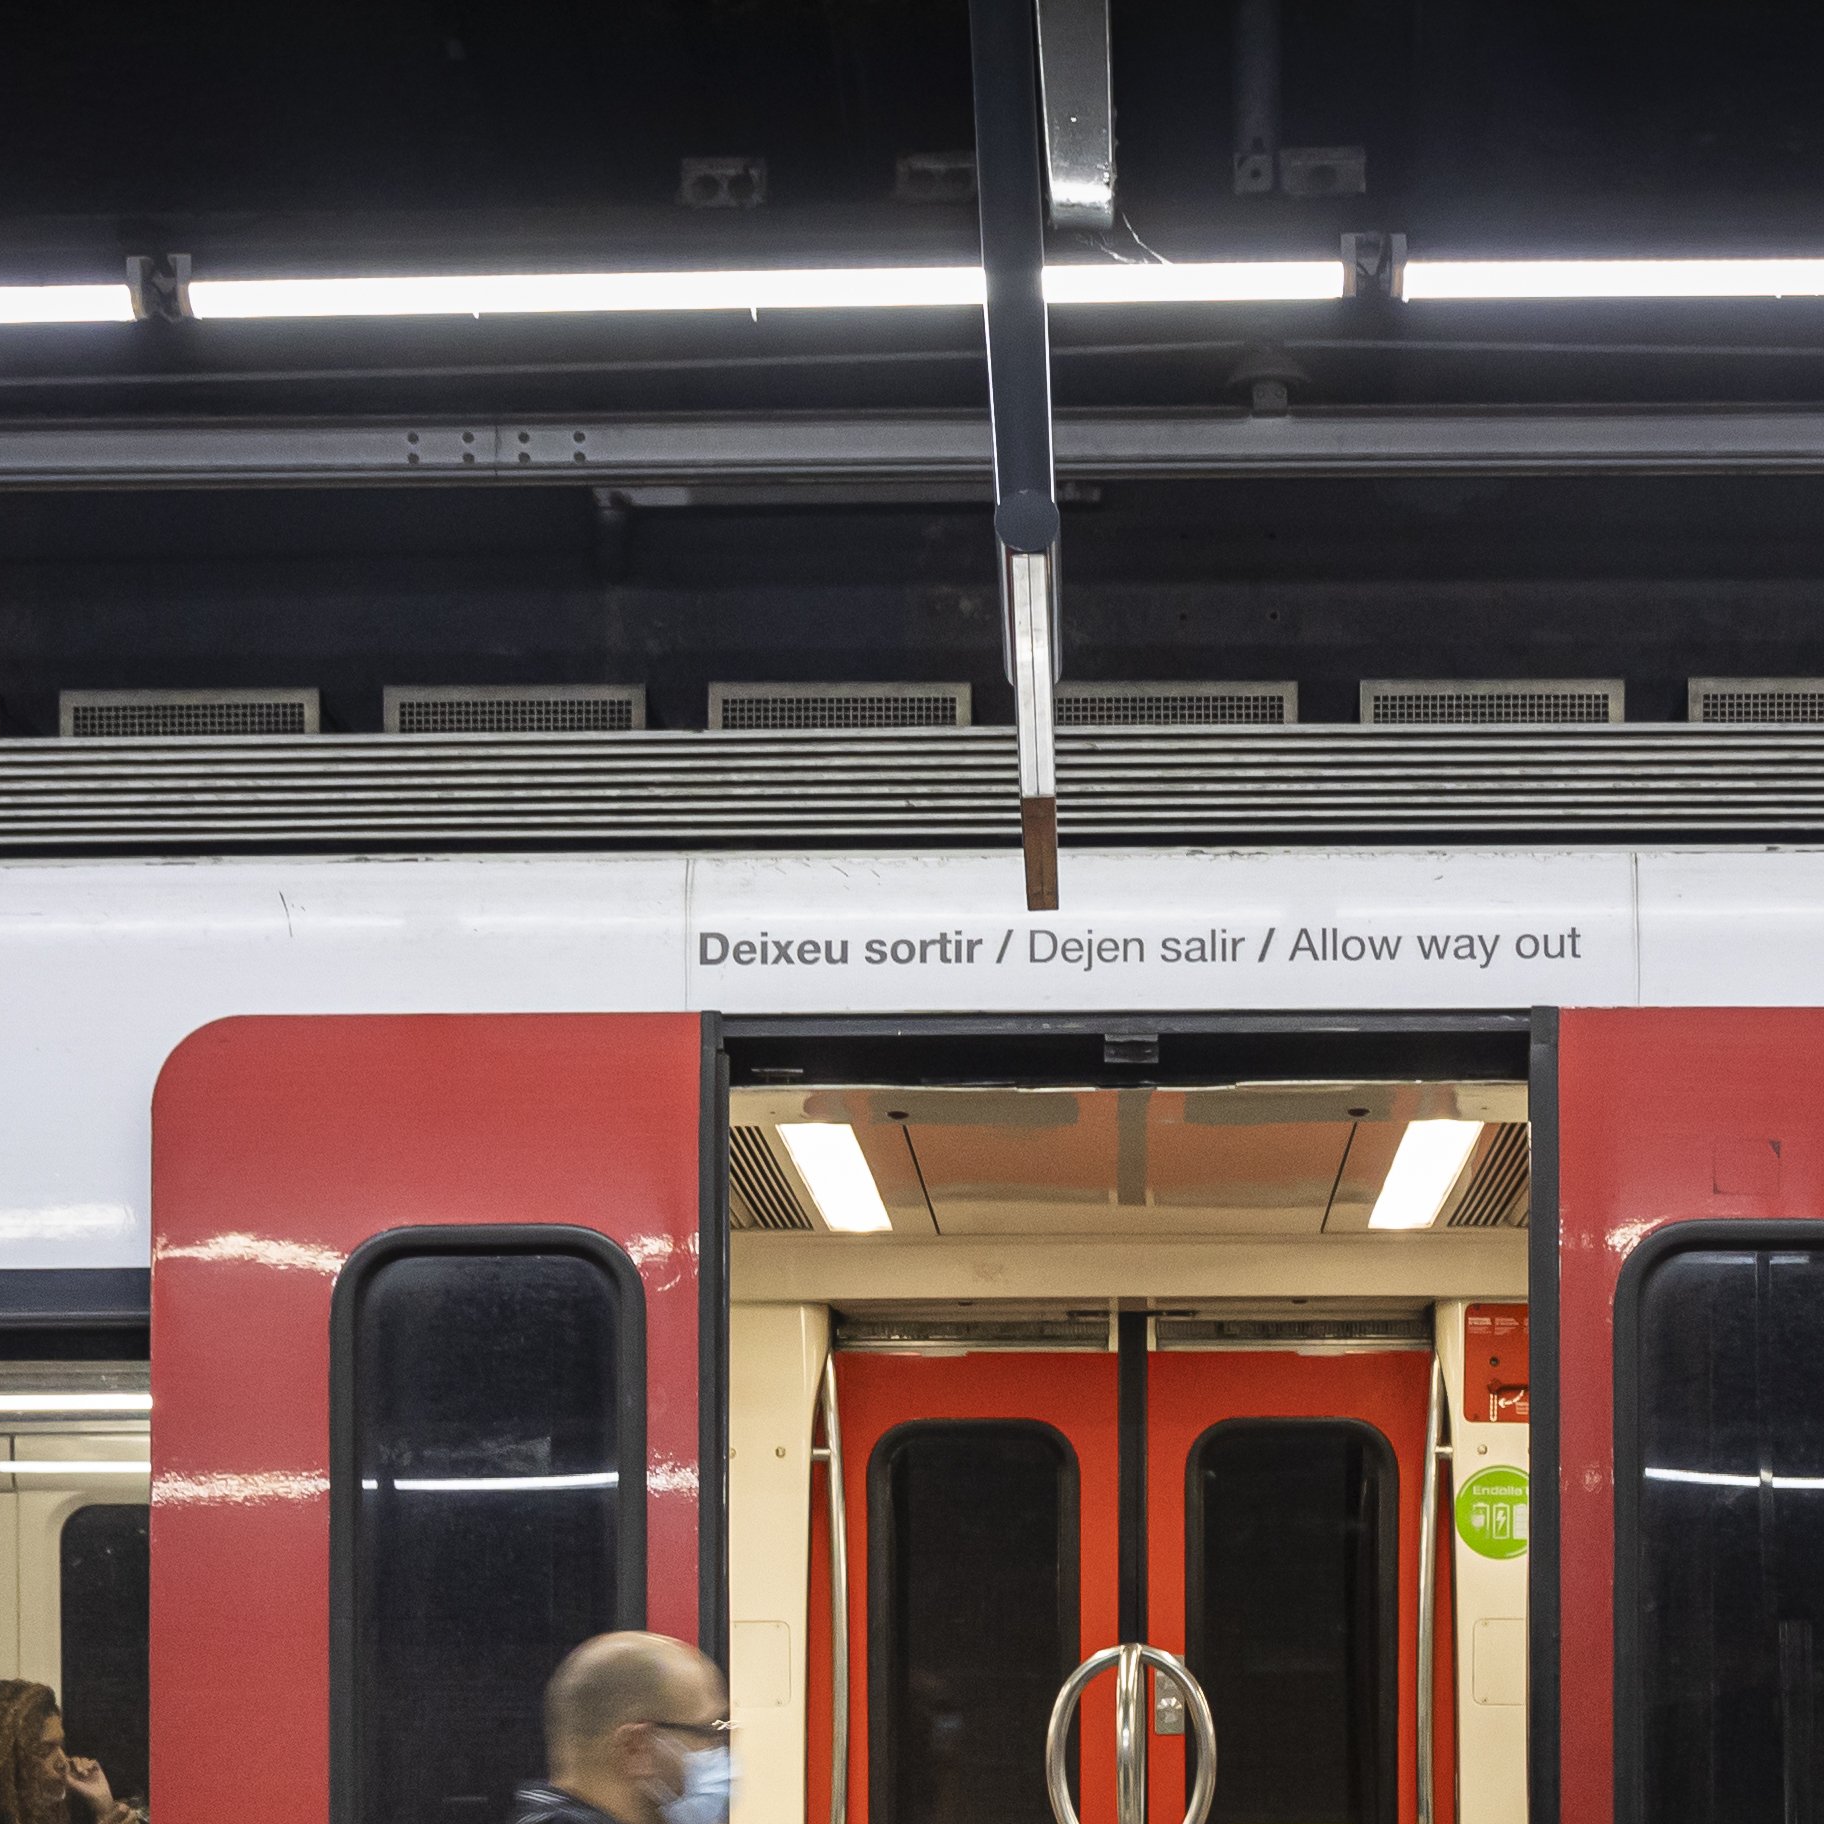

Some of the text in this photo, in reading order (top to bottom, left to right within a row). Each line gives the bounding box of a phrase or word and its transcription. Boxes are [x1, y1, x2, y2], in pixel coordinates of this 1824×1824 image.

[699, 926, 1582, 972] Deixeu sortir / Dejen salir / Allow way out
